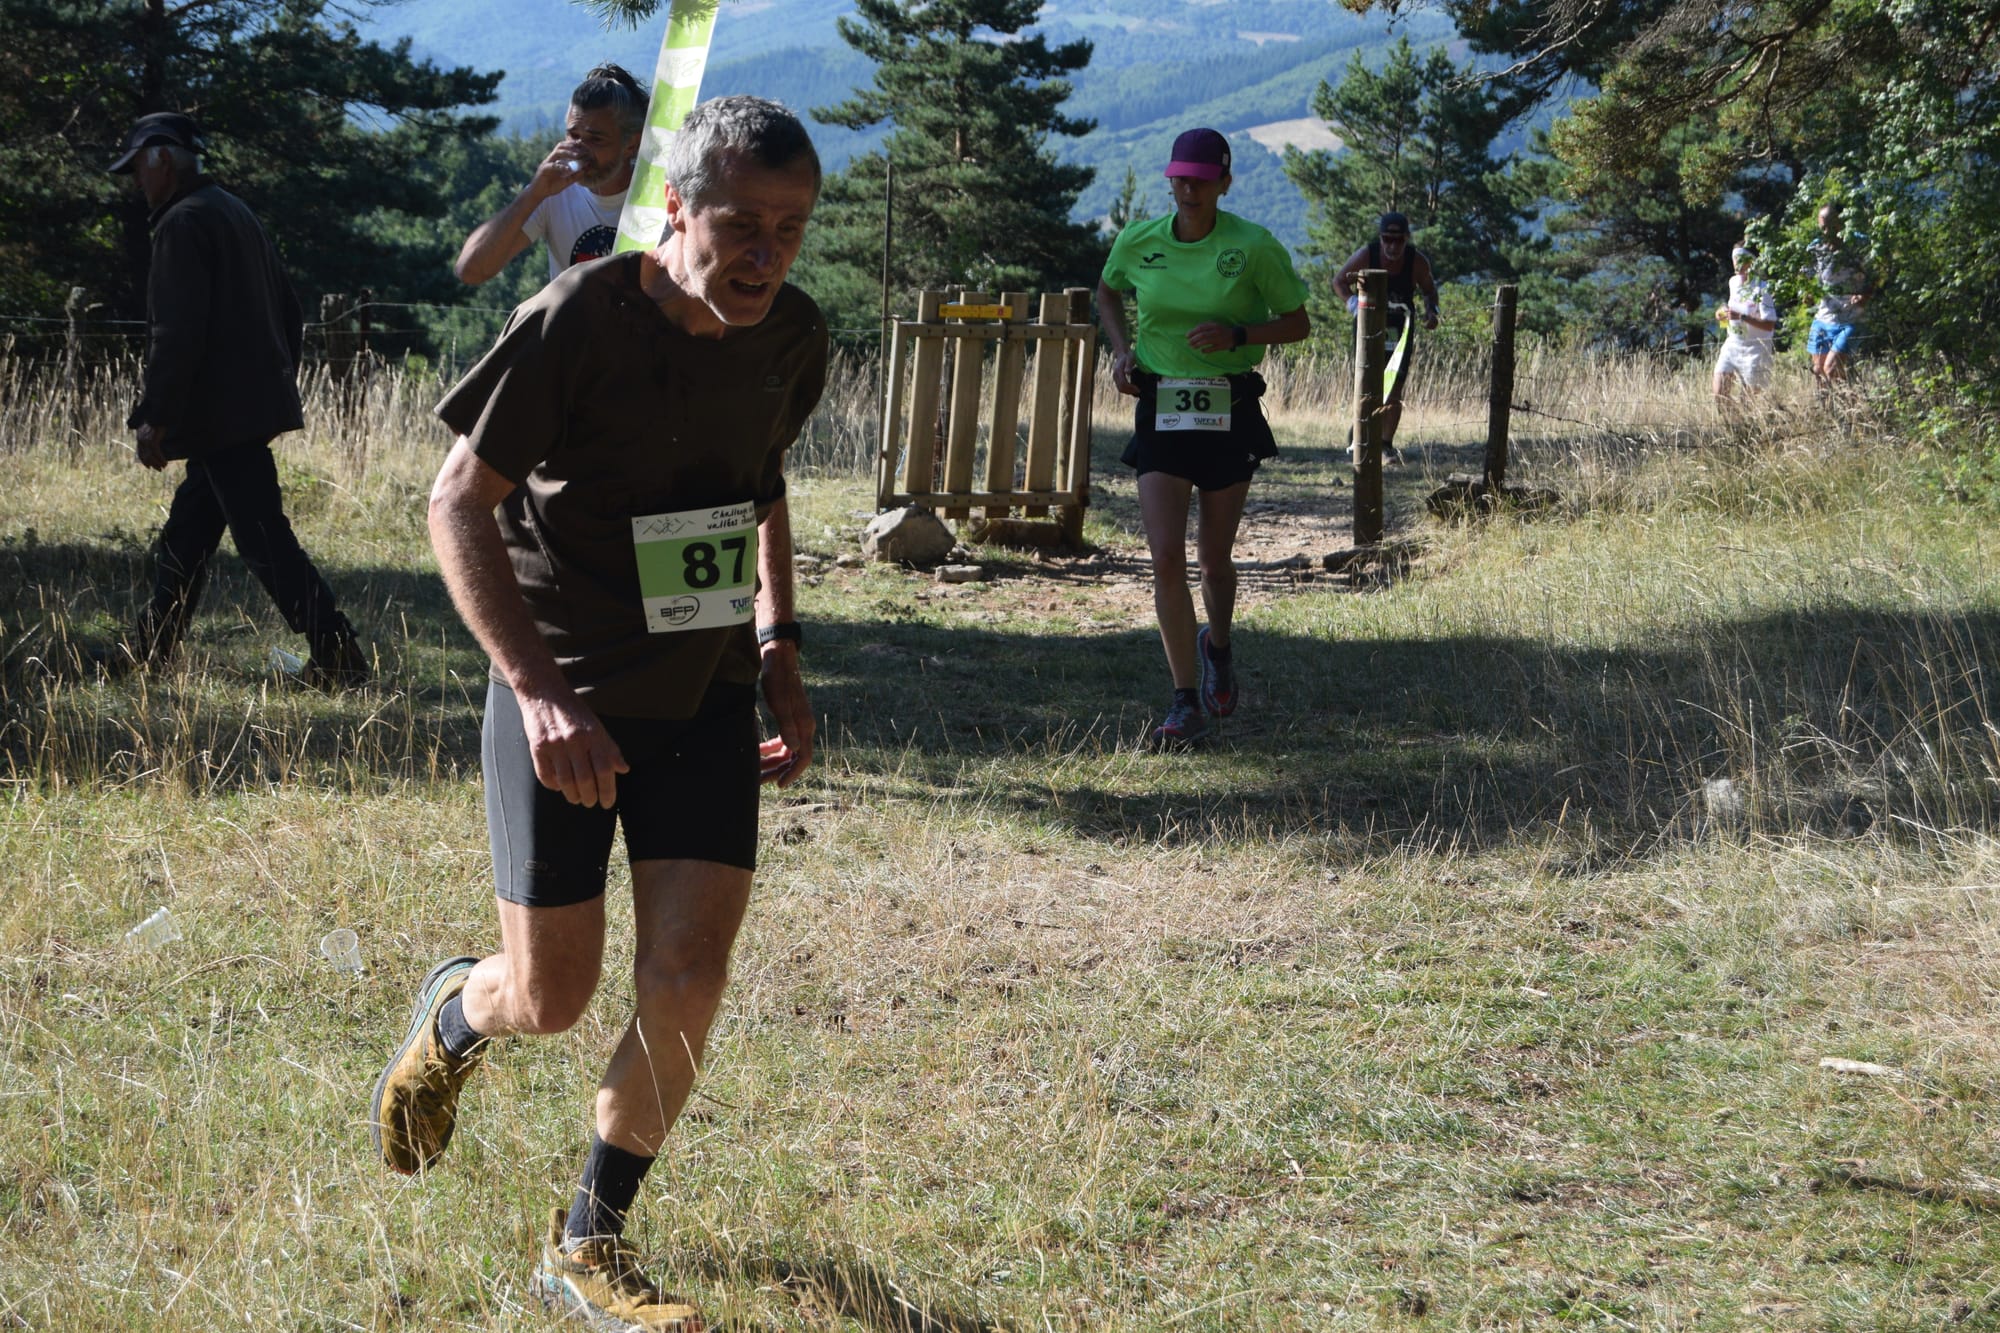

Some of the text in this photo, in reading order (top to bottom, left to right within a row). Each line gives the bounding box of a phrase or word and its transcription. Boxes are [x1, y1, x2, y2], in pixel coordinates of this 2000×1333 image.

[1176, 390, 1211, 412] 36
[682, 537, 747, 589] 87
[660, 605, 695, 617] BFP
